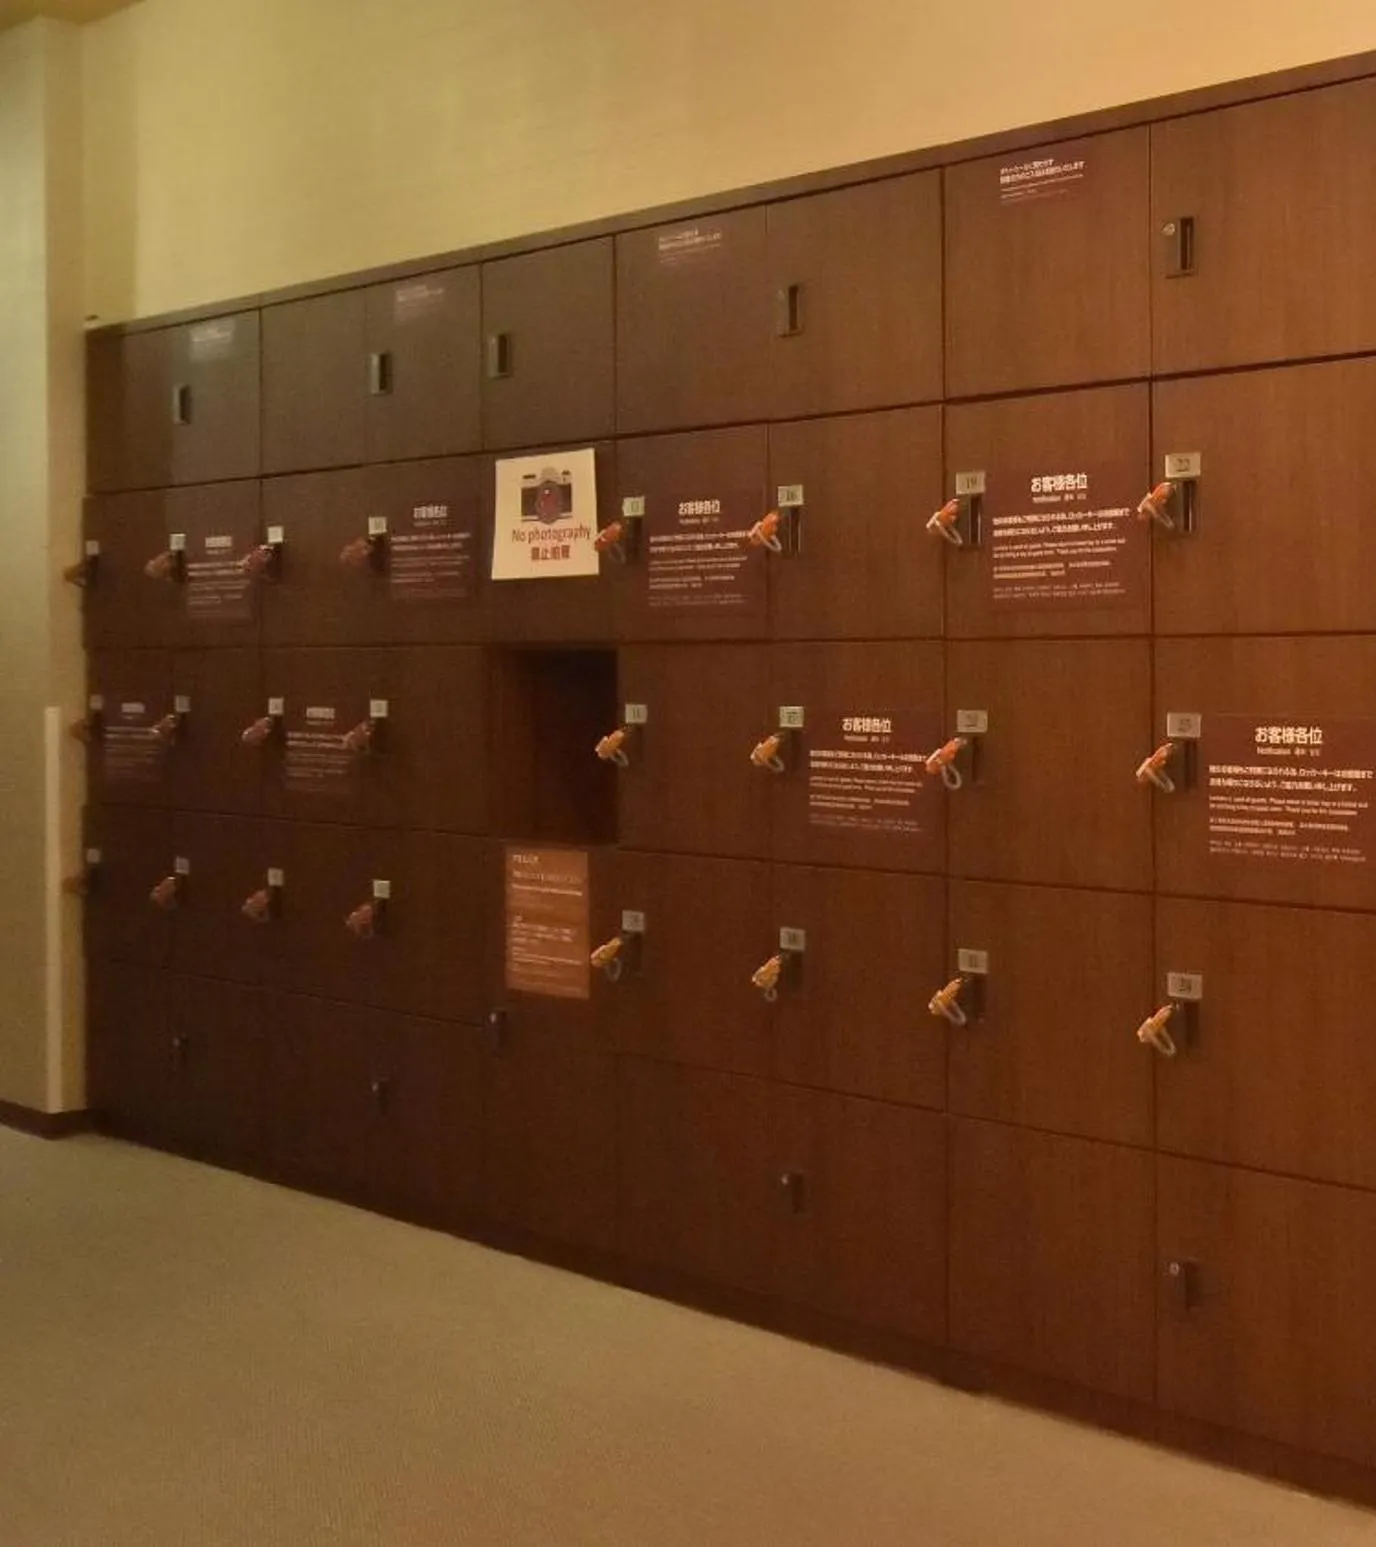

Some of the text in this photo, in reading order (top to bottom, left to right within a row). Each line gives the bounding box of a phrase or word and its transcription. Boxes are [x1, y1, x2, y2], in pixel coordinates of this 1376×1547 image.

[1176, 458, 1190, 472] 22
[512, 528, 526, 542] No
[1255, 725, 1324, 745] お客様各位
